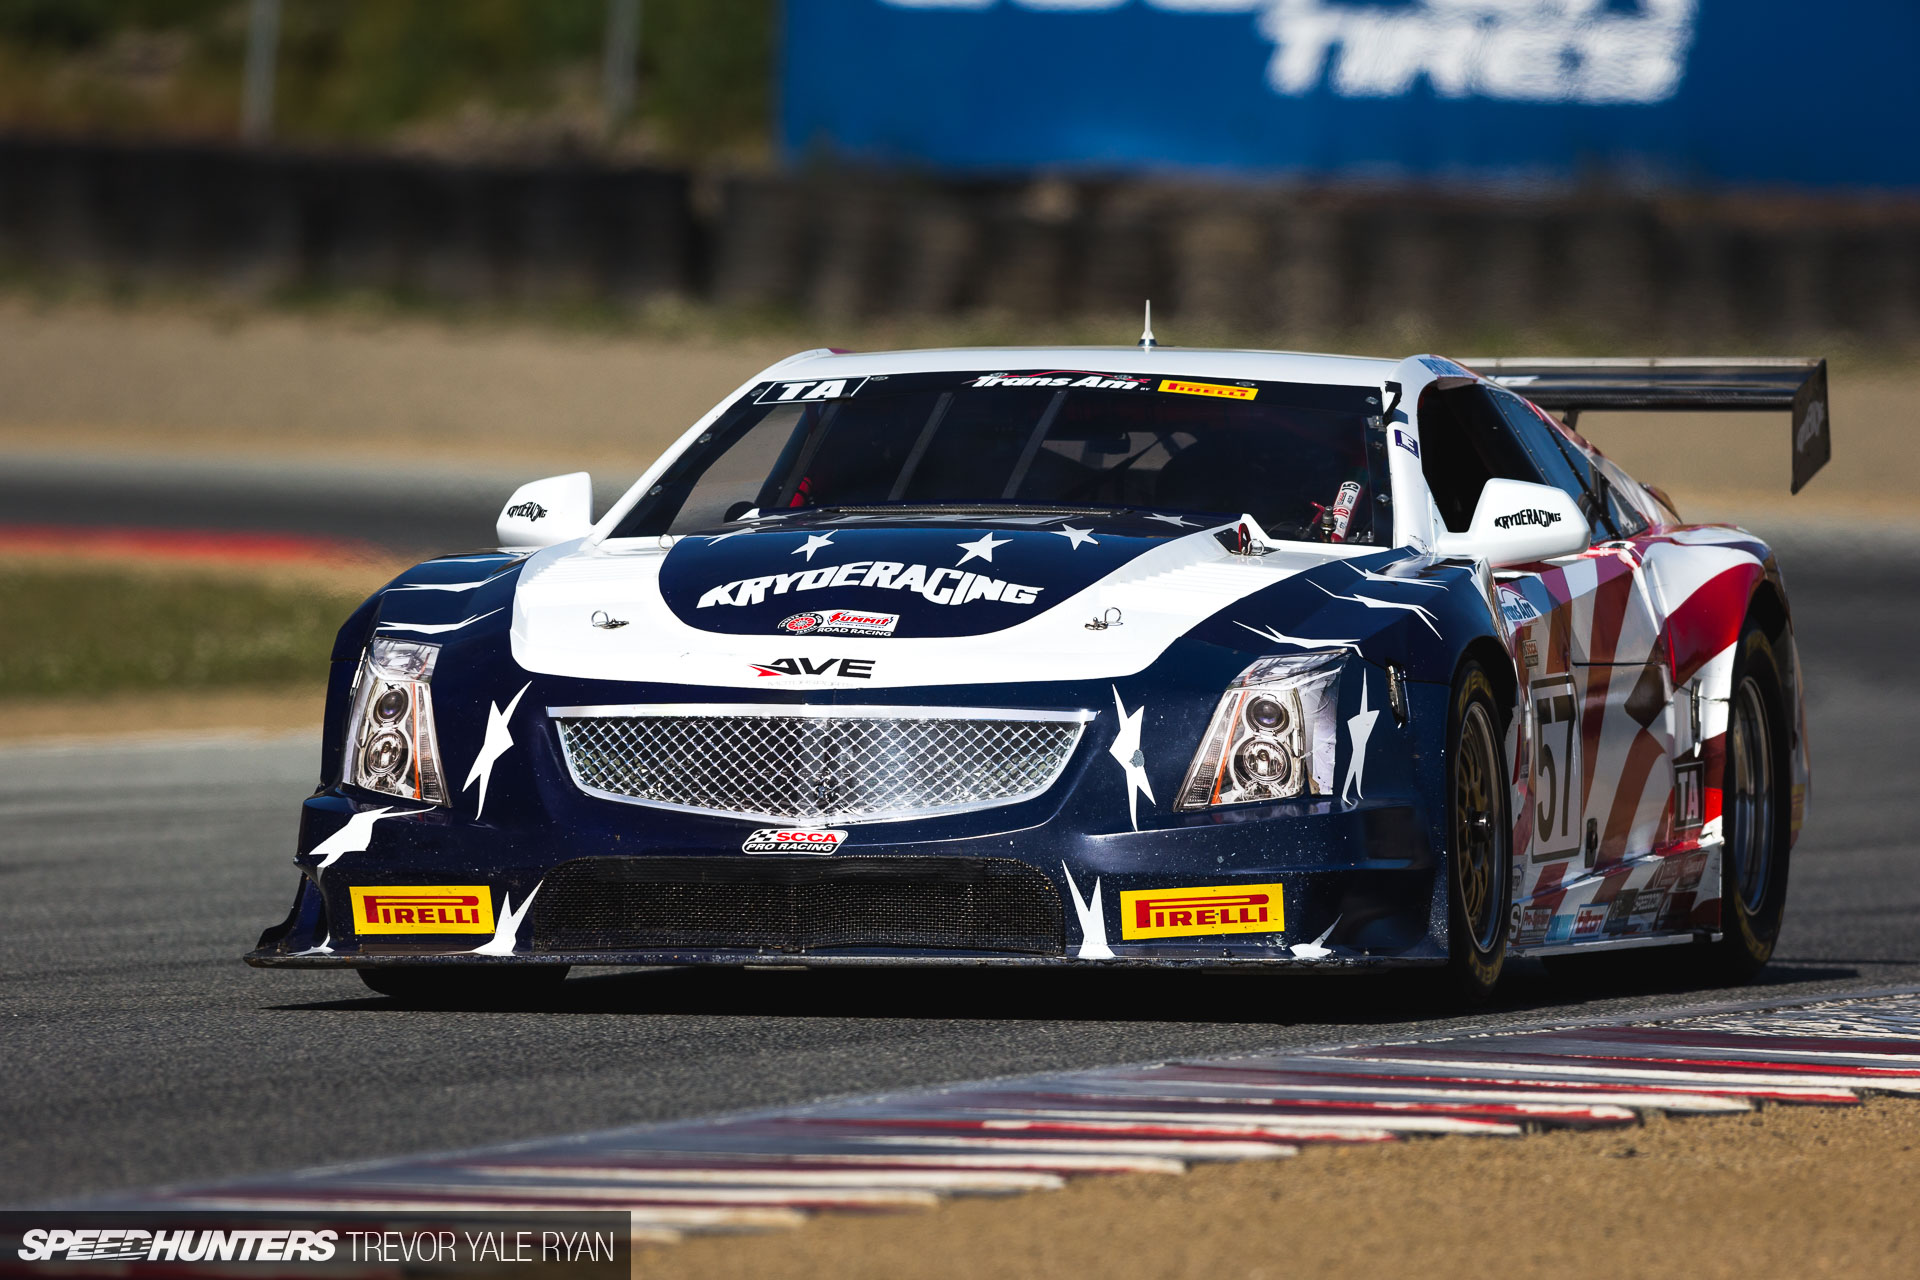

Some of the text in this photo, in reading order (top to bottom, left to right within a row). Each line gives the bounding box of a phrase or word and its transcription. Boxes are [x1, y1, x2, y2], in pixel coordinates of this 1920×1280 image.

[777, 379, 847, 400] TA
[972, 375, 1139, 390] Trans Am
[1167, 382, 1249, 397] PIRELLI
[1494, 508, 1562, 529] KRYDERACING
[696, 561, 1044, 608] KRYDERACING
[850, 628, 892, 637] RACING
[749, 657, 876, 679] AVE
[1536, 693, 1576, 842] 57
[1677, 770, 1699, 822] TA
[746, 843, 834, 852] PRO RACING
[776, 832, 837, 843] SCCA
[363, 895, 479, 924] PIRELLI
[1135, 894, 1270, 928] PIRELLI
